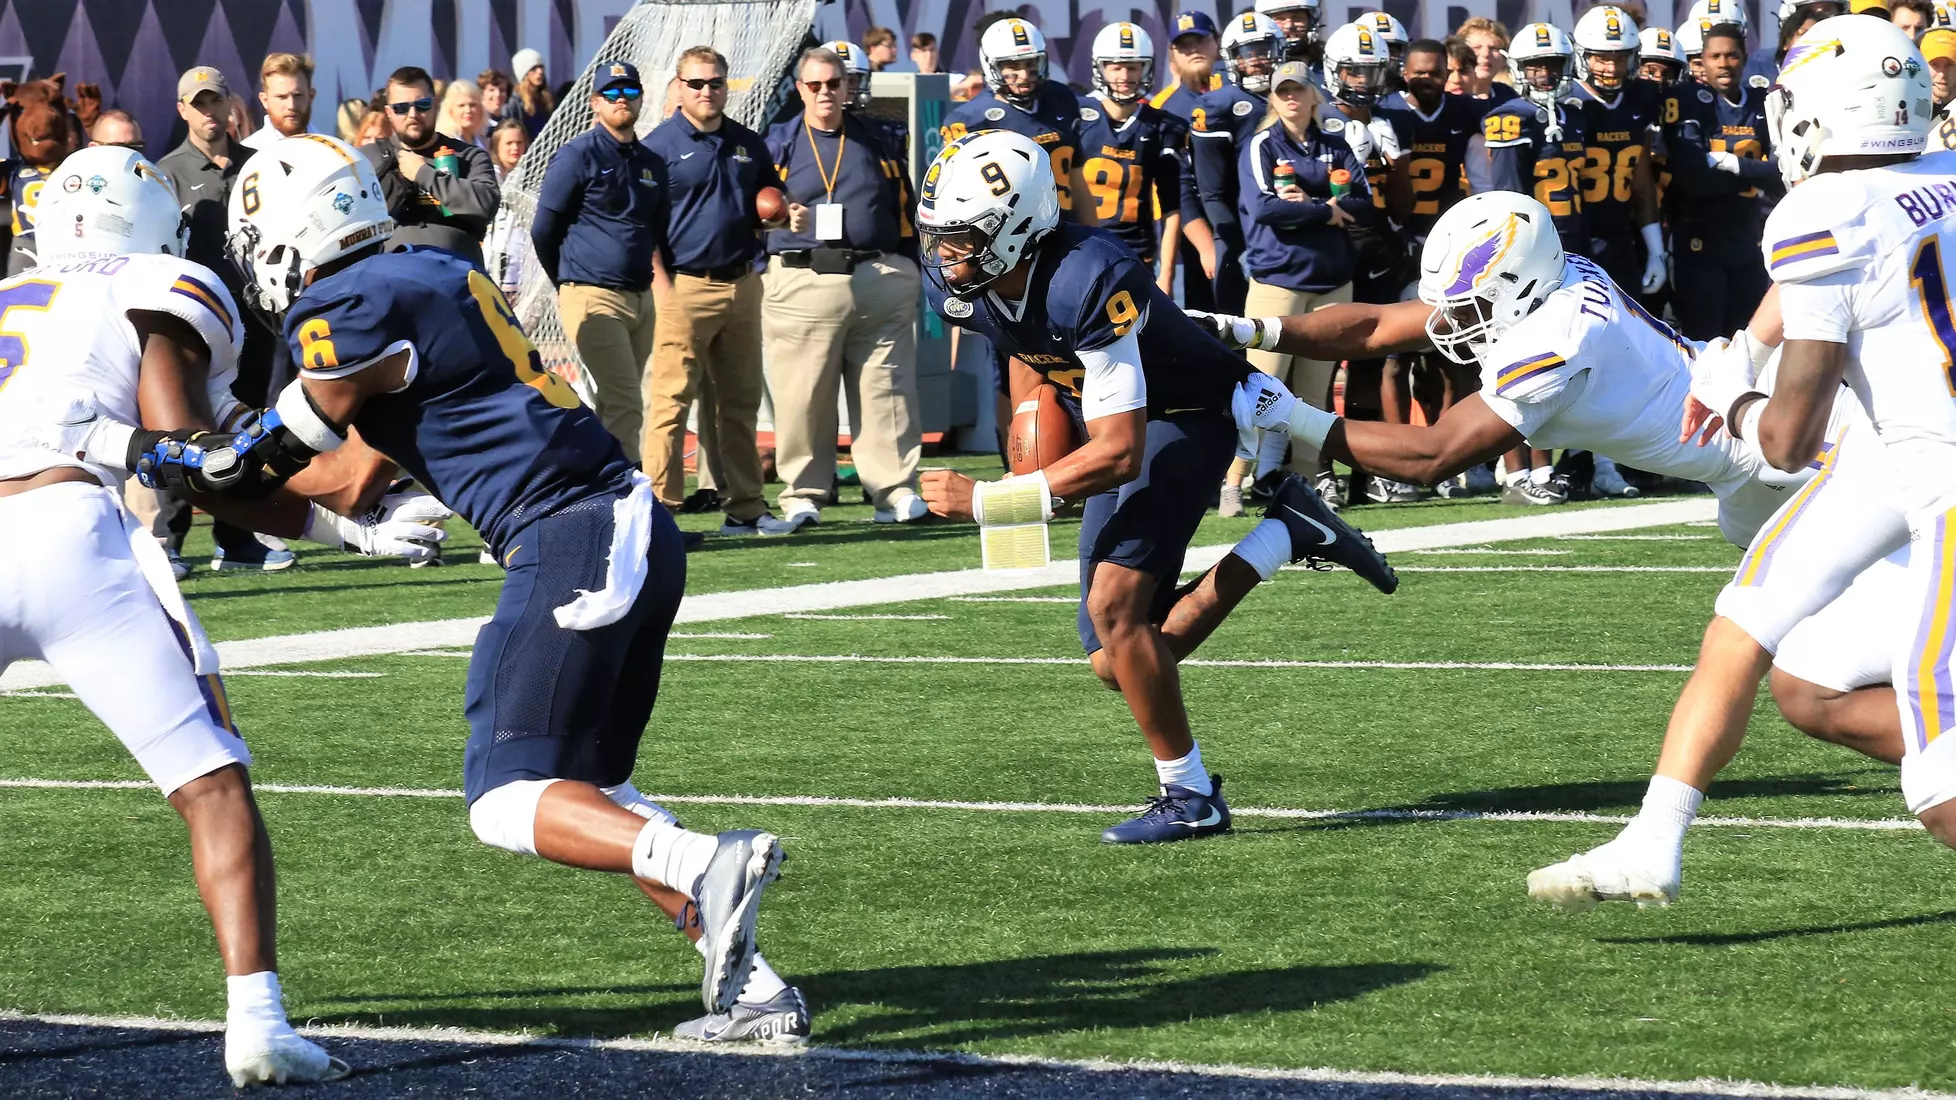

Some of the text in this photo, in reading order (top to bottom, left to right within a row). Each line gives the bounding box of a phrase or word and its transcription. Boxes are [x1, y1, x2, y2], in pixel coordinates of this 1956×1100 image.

[1484, 115, 1521, 141] 29
[1597, 131, 1631, 142] RACERS
[1860, 136, 1925, 148] #WINGSUP
[980, 162, 1013, 198] 9
[1082, 157, 1143, 223] 91
[242, 172, 260, 216] 6
[75, 223, 84, 238] 5
[339, 224, 377, 251] MURRAY
[1105, 289, 1139, 337] 9
[298, 318, 340, 369] 6
[1256, 392, 1283, 417] adidas
